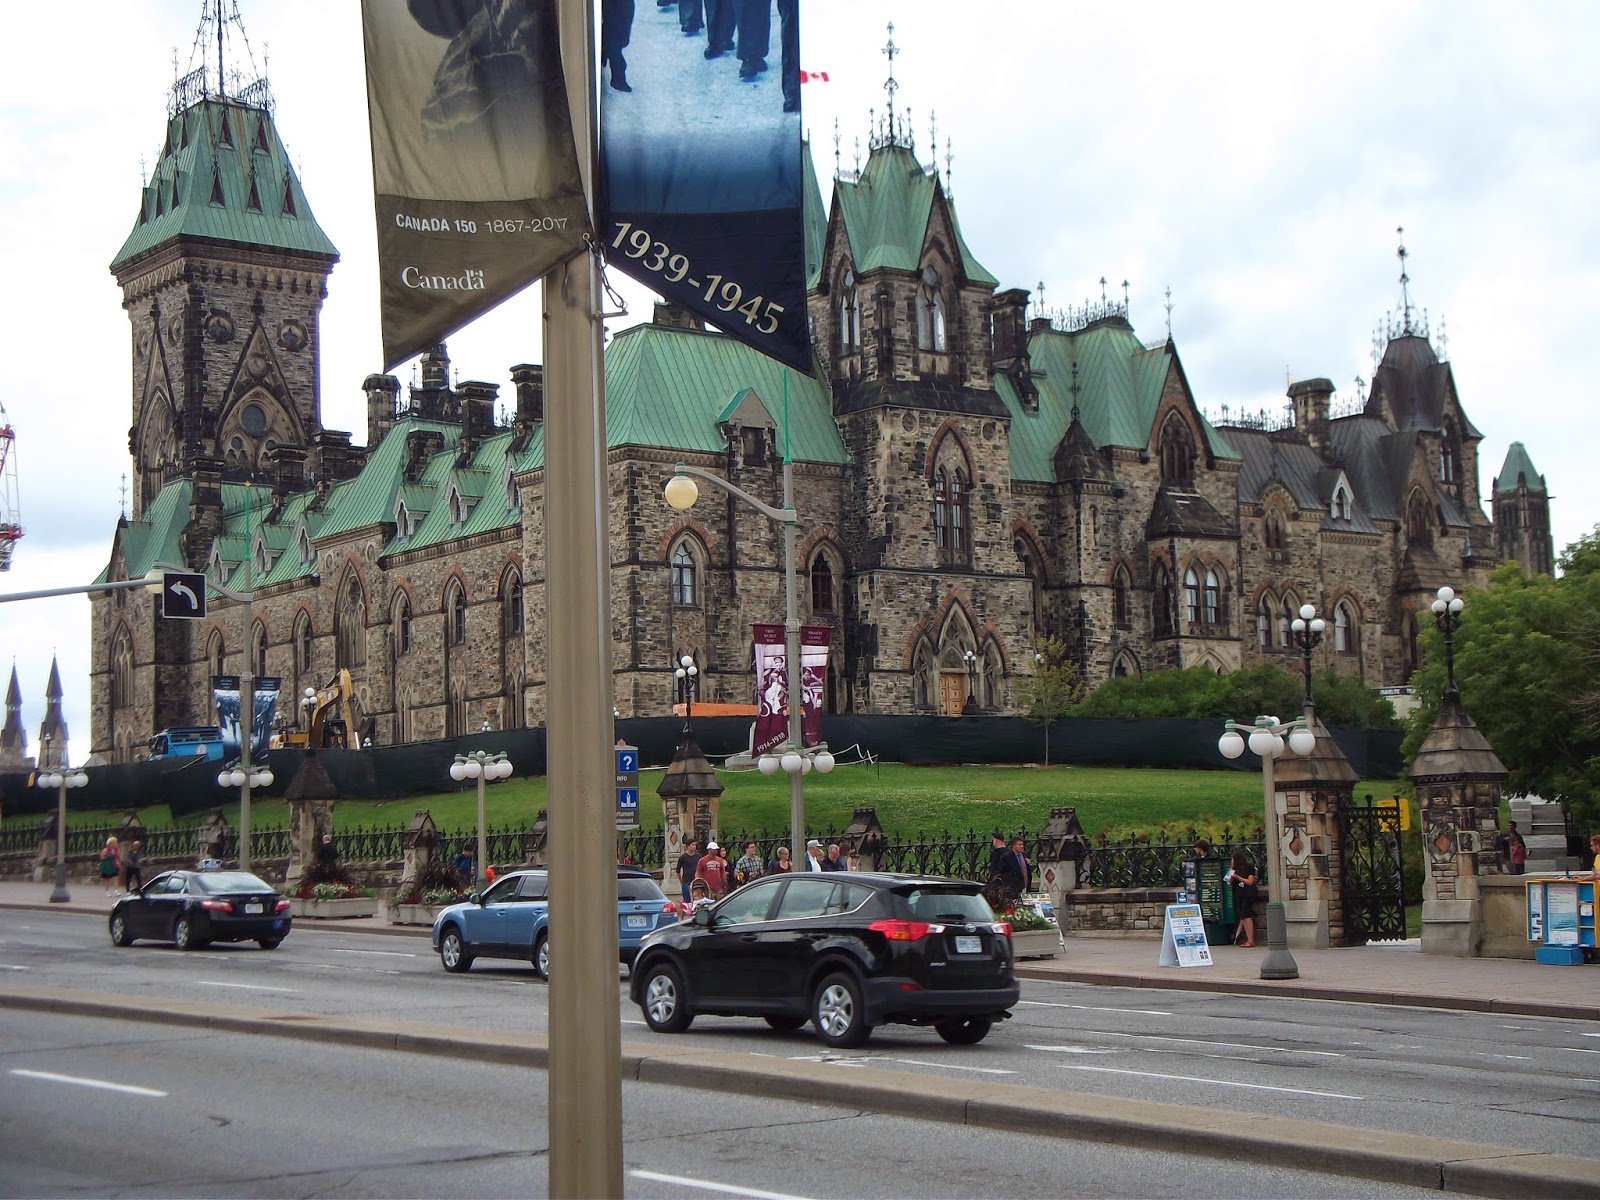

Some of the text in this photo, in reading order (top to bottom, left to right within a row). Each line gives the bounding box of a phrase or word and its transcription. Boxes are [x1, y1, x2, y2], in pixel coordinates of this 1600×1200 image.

[395, 213, 568, 234] CANADA 150 1867-2017
[401, 266, 485, 291] Canada
[611, 222, 785, 334] 1939-1945
[756, 731, 786, 752] 1914-1918
